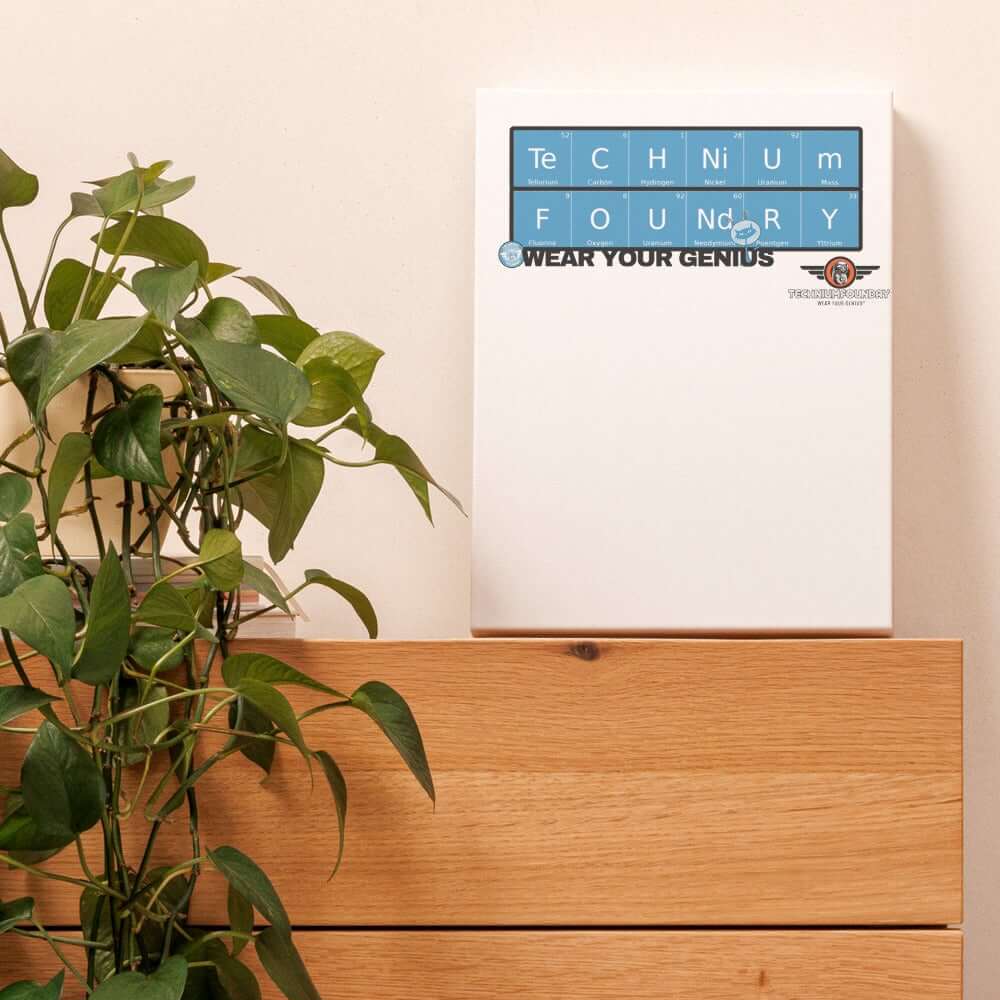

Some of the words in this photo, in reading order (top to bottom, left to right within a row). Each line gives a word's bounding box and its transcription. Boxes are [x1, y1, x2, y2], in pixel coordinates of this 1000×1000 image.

[527, 147, 557, 170] Te
[591, 147, 609, 170] C
[648, 147, 667, 170] H
[702, 146, 728, 170] Ni
[763, 147, 782, 170] U
[817, 151, 842, 170] m
[536, 207, 550, 230] F
[590, 207, 610, 231] O
[648, 207, 667, 231] U
[697, 206, 733, 231] Nd
[764, 207, 782, 230] R
[820, 207, 840, 230] Y
[522, 249, 595, 268] WEAR
[602, 249, 673, 268] YOUR
[679, 249, 775, 268] GENIUS
